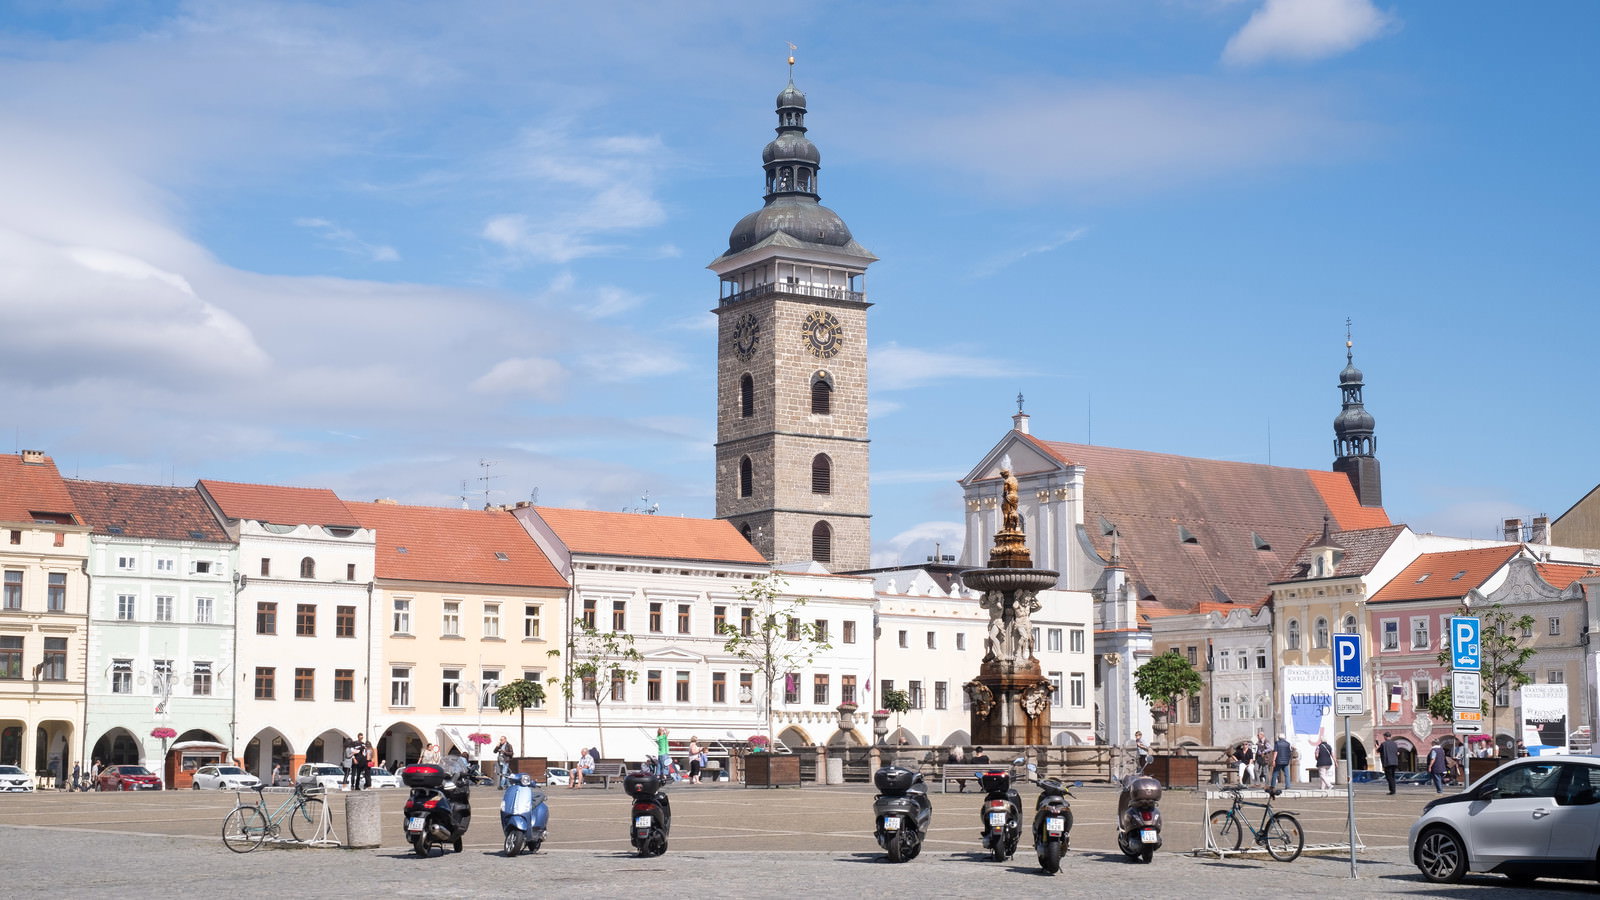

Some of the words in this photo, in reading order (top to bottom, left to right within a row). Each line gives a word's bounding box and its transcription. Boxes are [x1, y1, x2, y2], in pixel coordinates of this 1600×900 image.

[1457, 623, 1474, 653] P
[1339, 641, 1356, 672] P
[1289, 690, 1331, 704] ATELIÉR
